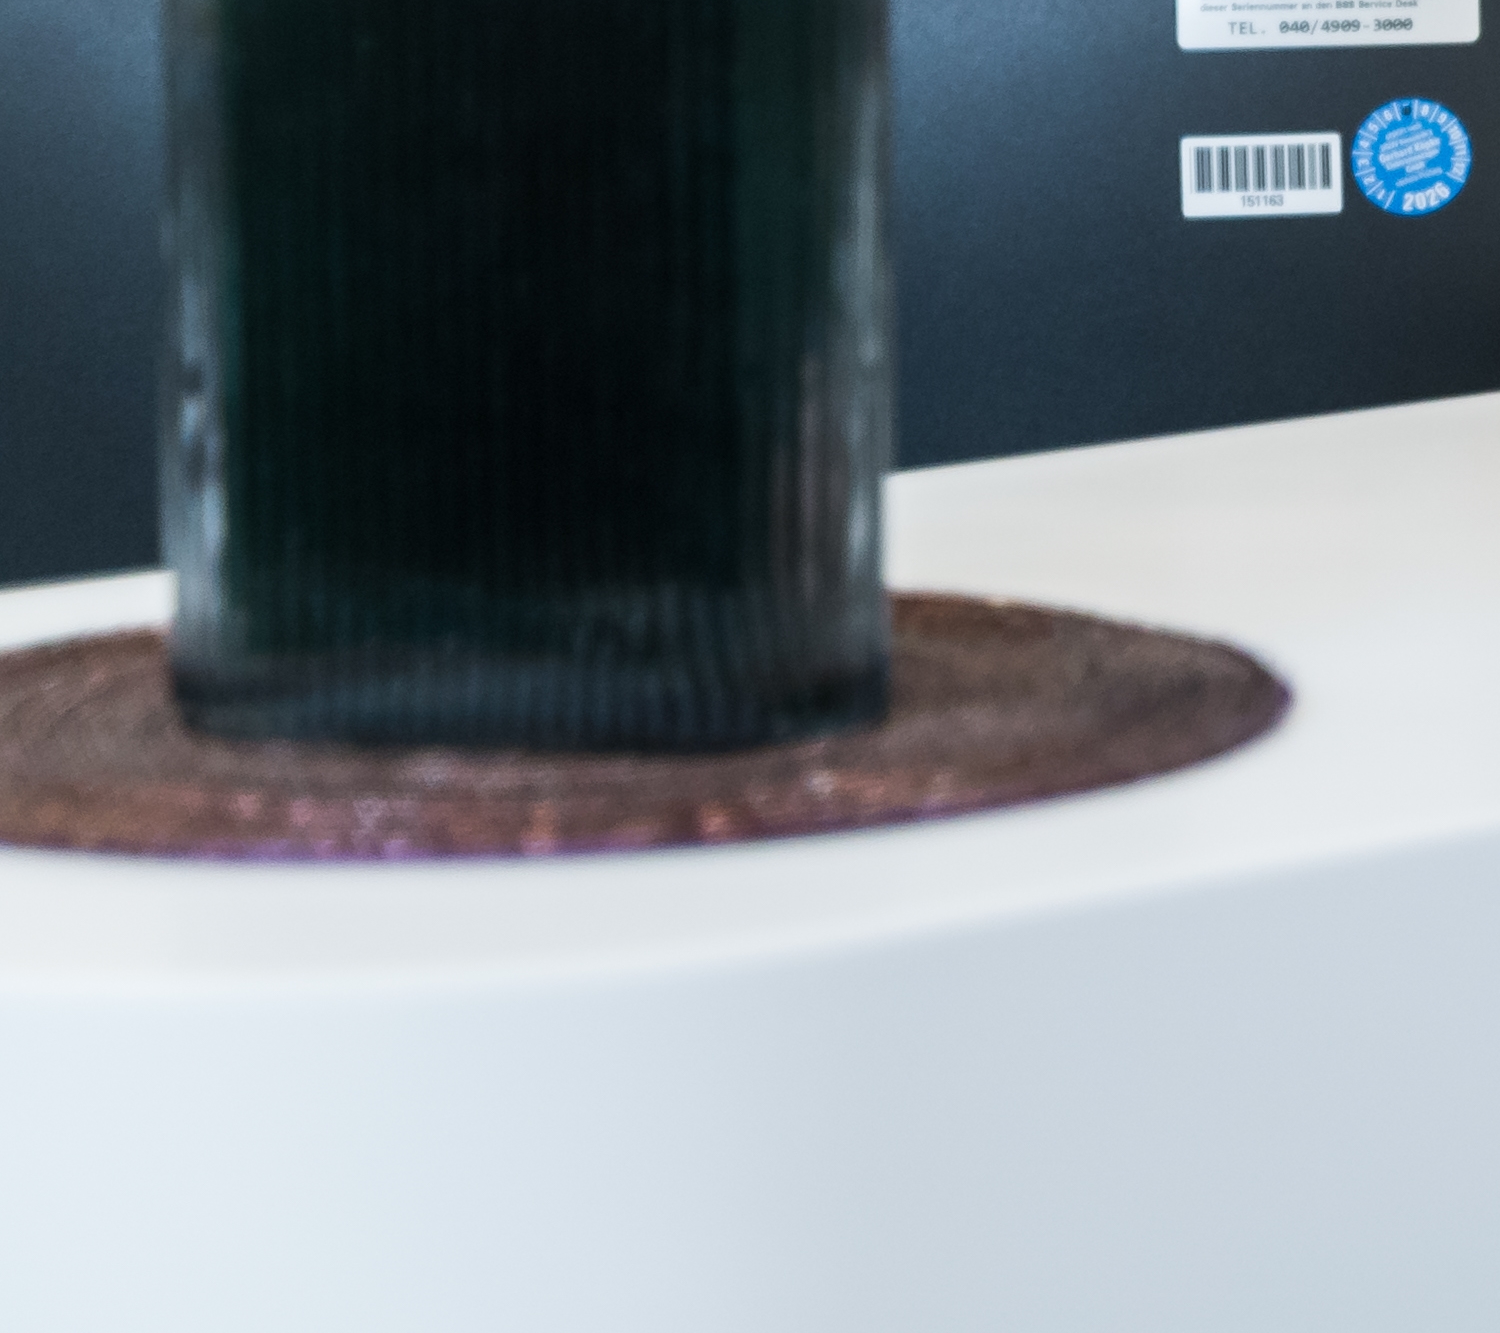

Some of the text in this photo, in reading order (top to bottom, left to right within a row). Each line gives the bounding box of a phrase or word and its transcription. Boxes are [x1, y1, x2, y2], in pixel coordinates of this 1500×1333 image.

[1200, 0, 1418, 12] dieser Seriennummer an den BSS Service Desk
[1228, 21, 1266, 35] TEL.
[1402, 182, 1450, 211] 2026
